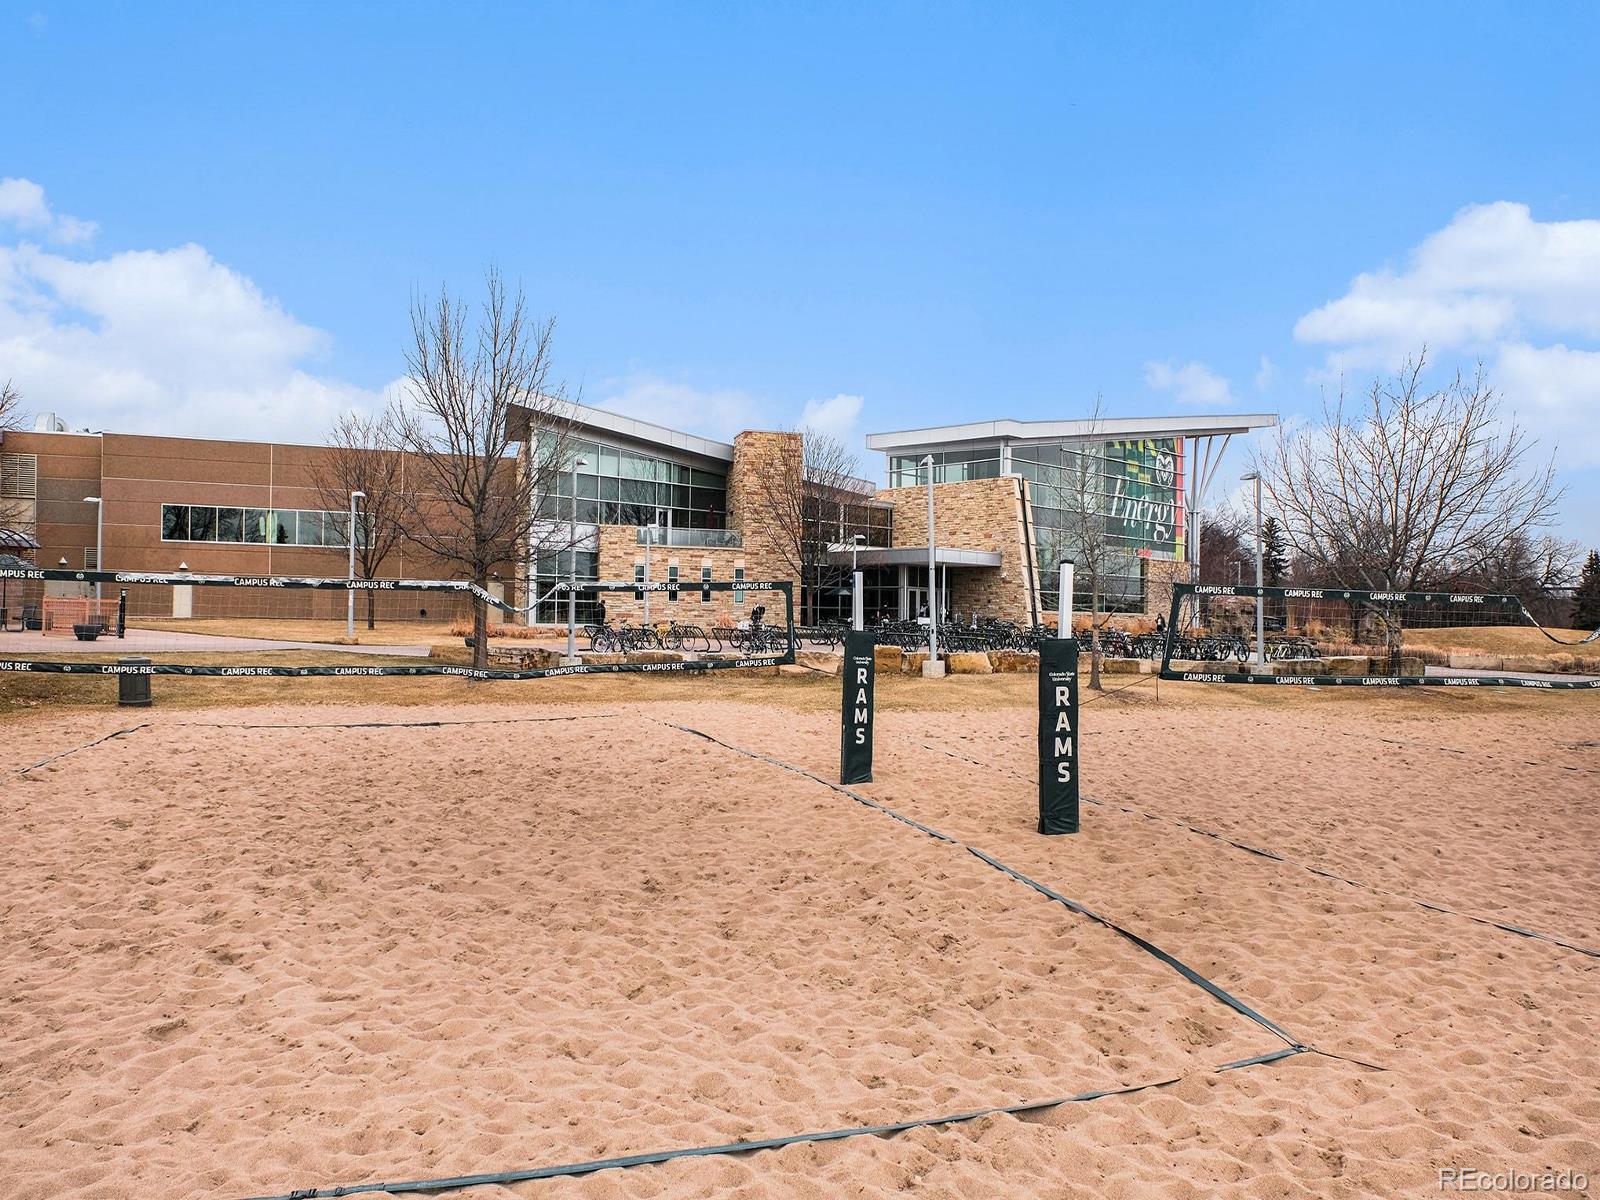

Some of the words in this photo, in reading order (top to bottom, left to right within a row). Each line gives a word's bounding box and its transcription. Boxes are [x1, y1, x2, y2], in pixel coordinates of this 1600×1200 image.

[1111, 474, 1175, 544] Energy
[0, 569, 26, 578] MPUS
[28, 570, 45, 579] REC
[234, 577, 269, 586] CAMPUS
[346, 581, 379, 589] CAMPUS
[380, 581, 395, 589] REC
[731, 582, 759, 590] CAMPUS
[759, 582, 773, 590] REC
[667, 583, 680, 591] REC
[1194, 585, 1222, 594] CAMPUS
[1222, 586, 1236, 595] REC
[1284, 589, 1310, 598] CAMPUS
[1311, 590, 1323, 599] REC
[1369, 592, 1394, 600] CAMPUS
[1395, 593, 1407, 601] REC
[14, 662, 32, 671] REC
[642, 663, 671, 671] CAMPUS
[671, 662, 685, 671] REC
[735, 659, 761, 667] CAMPUS
[762, 658, 775, 666] REC
[102, 665, 138, 674] CAMPUS
[139, 666, 156, 674] REC
[221, 667, 256, 675] CAMPUS
[256, 667, 273, 675] REC
[368, 668, 384, 676] REC
[442, 666, 474, 677] CAMPUS
[474, 669, 489, 678] REC
[545, 666, 575, 677] CAMPUS
[574, 665, 589, 673] REC
[1183, 672, 1211, 682] CAMPUS
[1212, 673, 1226, 683] REC
[1275, 676, 1302, 685] CAMPUS
[1302, 676, 1315, 685] REC
[1362, 677, 1387, 685] CAMPUS
[1388, 677, 1400, 685] REC
[1443, 678, 1468, 686] CAMPUS
[1468, 678, 1480, 686] REC
[854, 667, 868, 745] RAMS
[1054, 686, 1073, 783] RAMS
